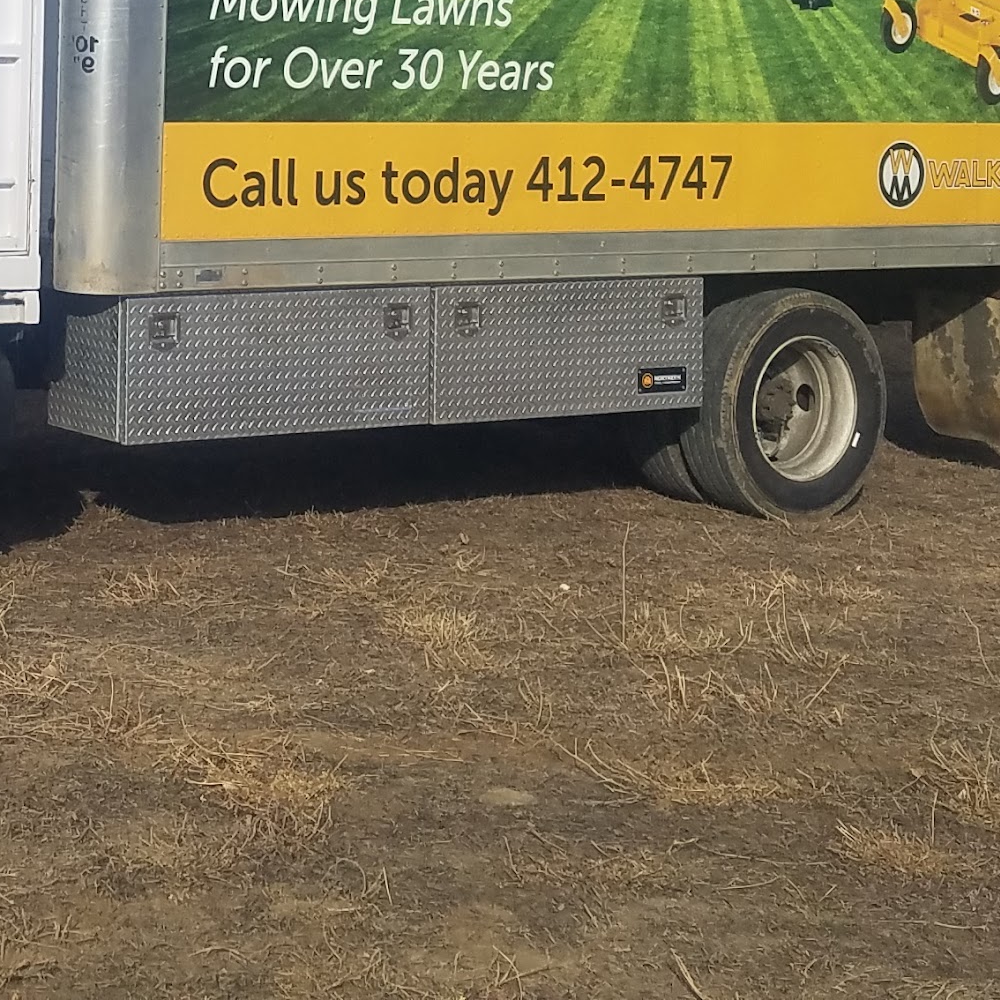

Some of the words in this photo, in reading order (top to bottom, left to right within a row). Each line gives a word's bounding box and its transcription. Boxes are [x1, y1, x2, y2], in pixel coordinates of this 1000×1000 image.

[207, 45, 271, 89] for
[282, 47, 383, 90] Over
[391, 48, 444, 91] 30
[458, 50, 555, 92] Years
[202, 157, 298, 208] Call
[315, 168, 366, 206] us
[381, 156, 514, 216] today
[526, 154, 734, 203] 412-4747
[926, 158, 1000, 189] WALK
